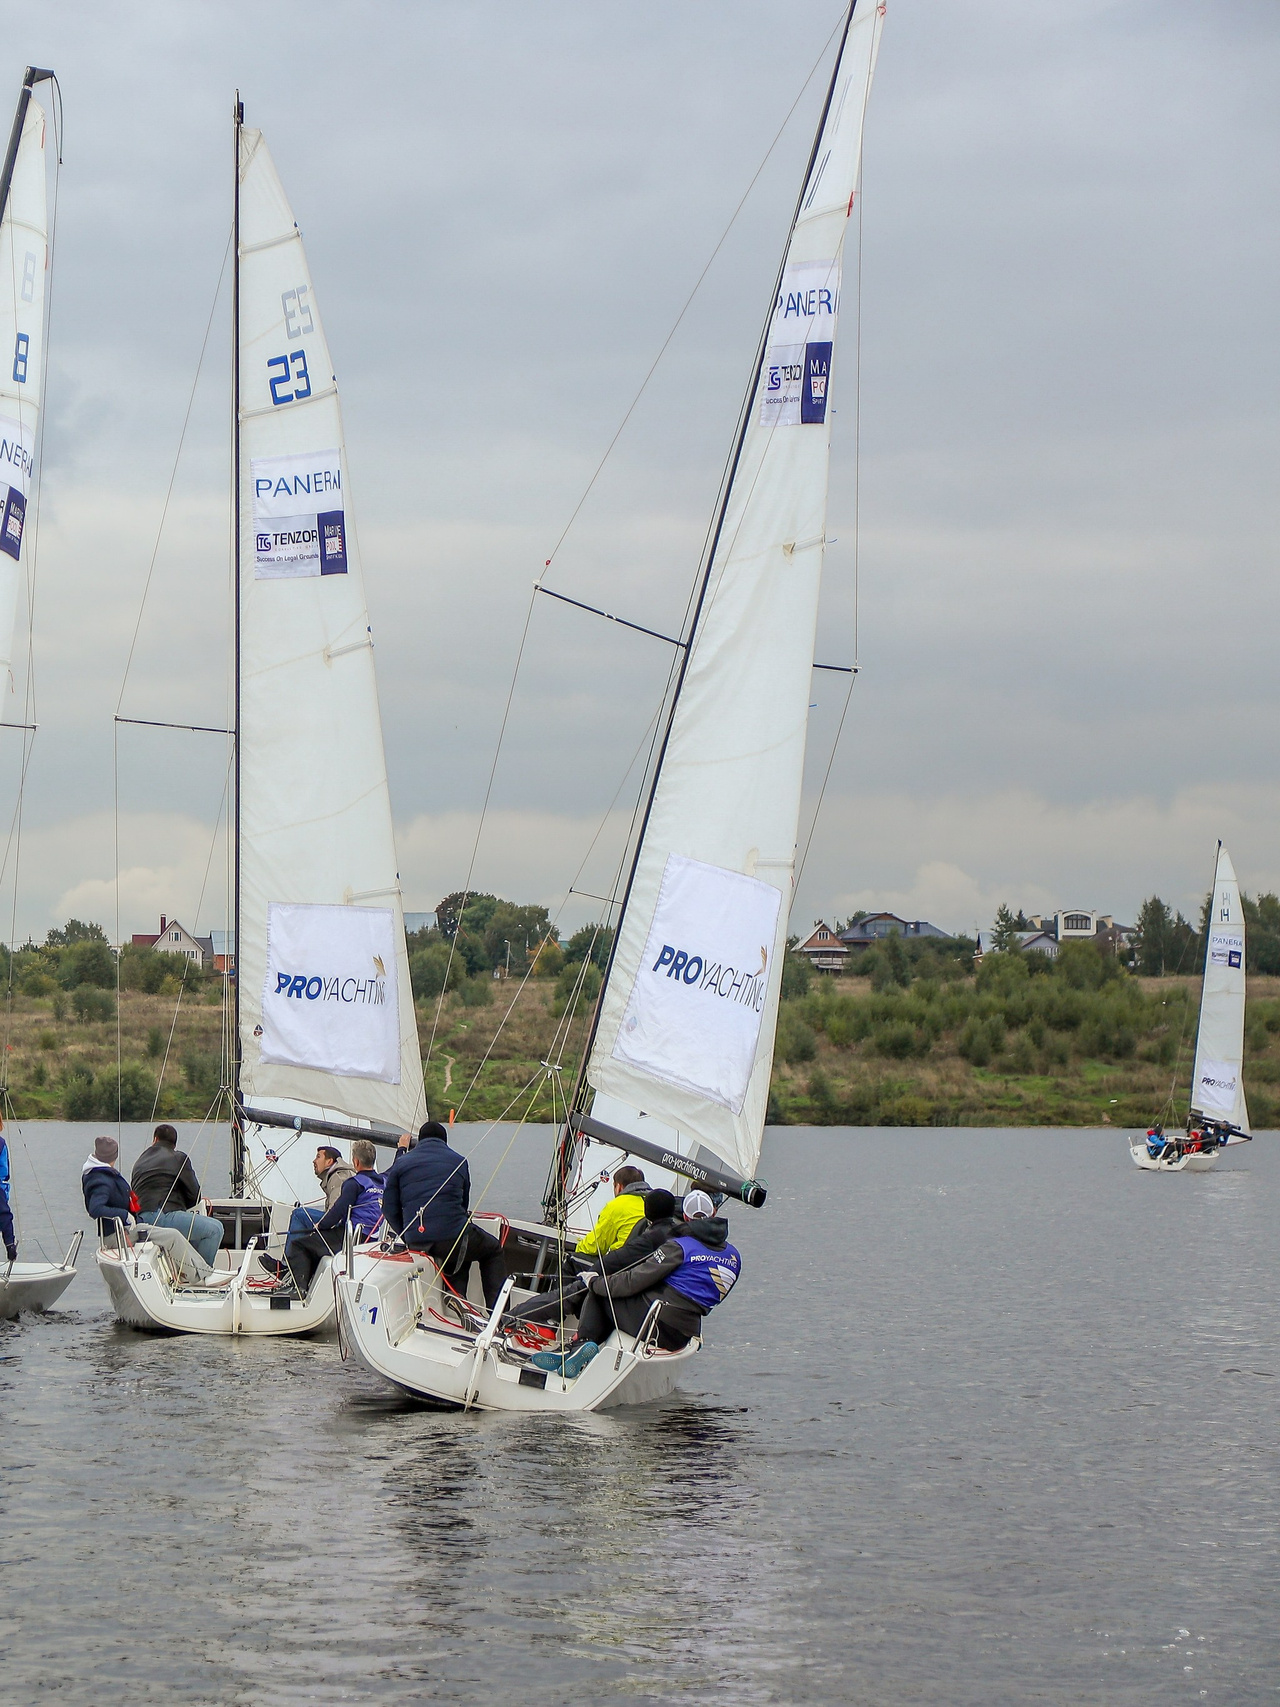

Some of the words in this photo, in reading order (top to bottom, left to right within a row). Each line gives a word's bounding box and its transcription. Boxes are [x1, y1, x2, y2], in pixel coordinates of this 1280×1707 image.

[13, 332, 29, 383] 8
[267, 349, 311, 405] 23
[256, 470, 341, 498] PANERAI
[273, 529, 318, 546] TENZOR
[256, 555, 275, 563] Success
[284, 554, 299, 563] Legal
[299, 552, 320, 561] Grounds
[652, 944, 765, 1013] PROYACHTING
[661, 1152, 708, 1180] pro-yachting.ru
[690, 1254, 738, 1269] PROYACHTING
[140, 1272, 152, 1281] 23
[368, 1306, 378, 1325] 1
